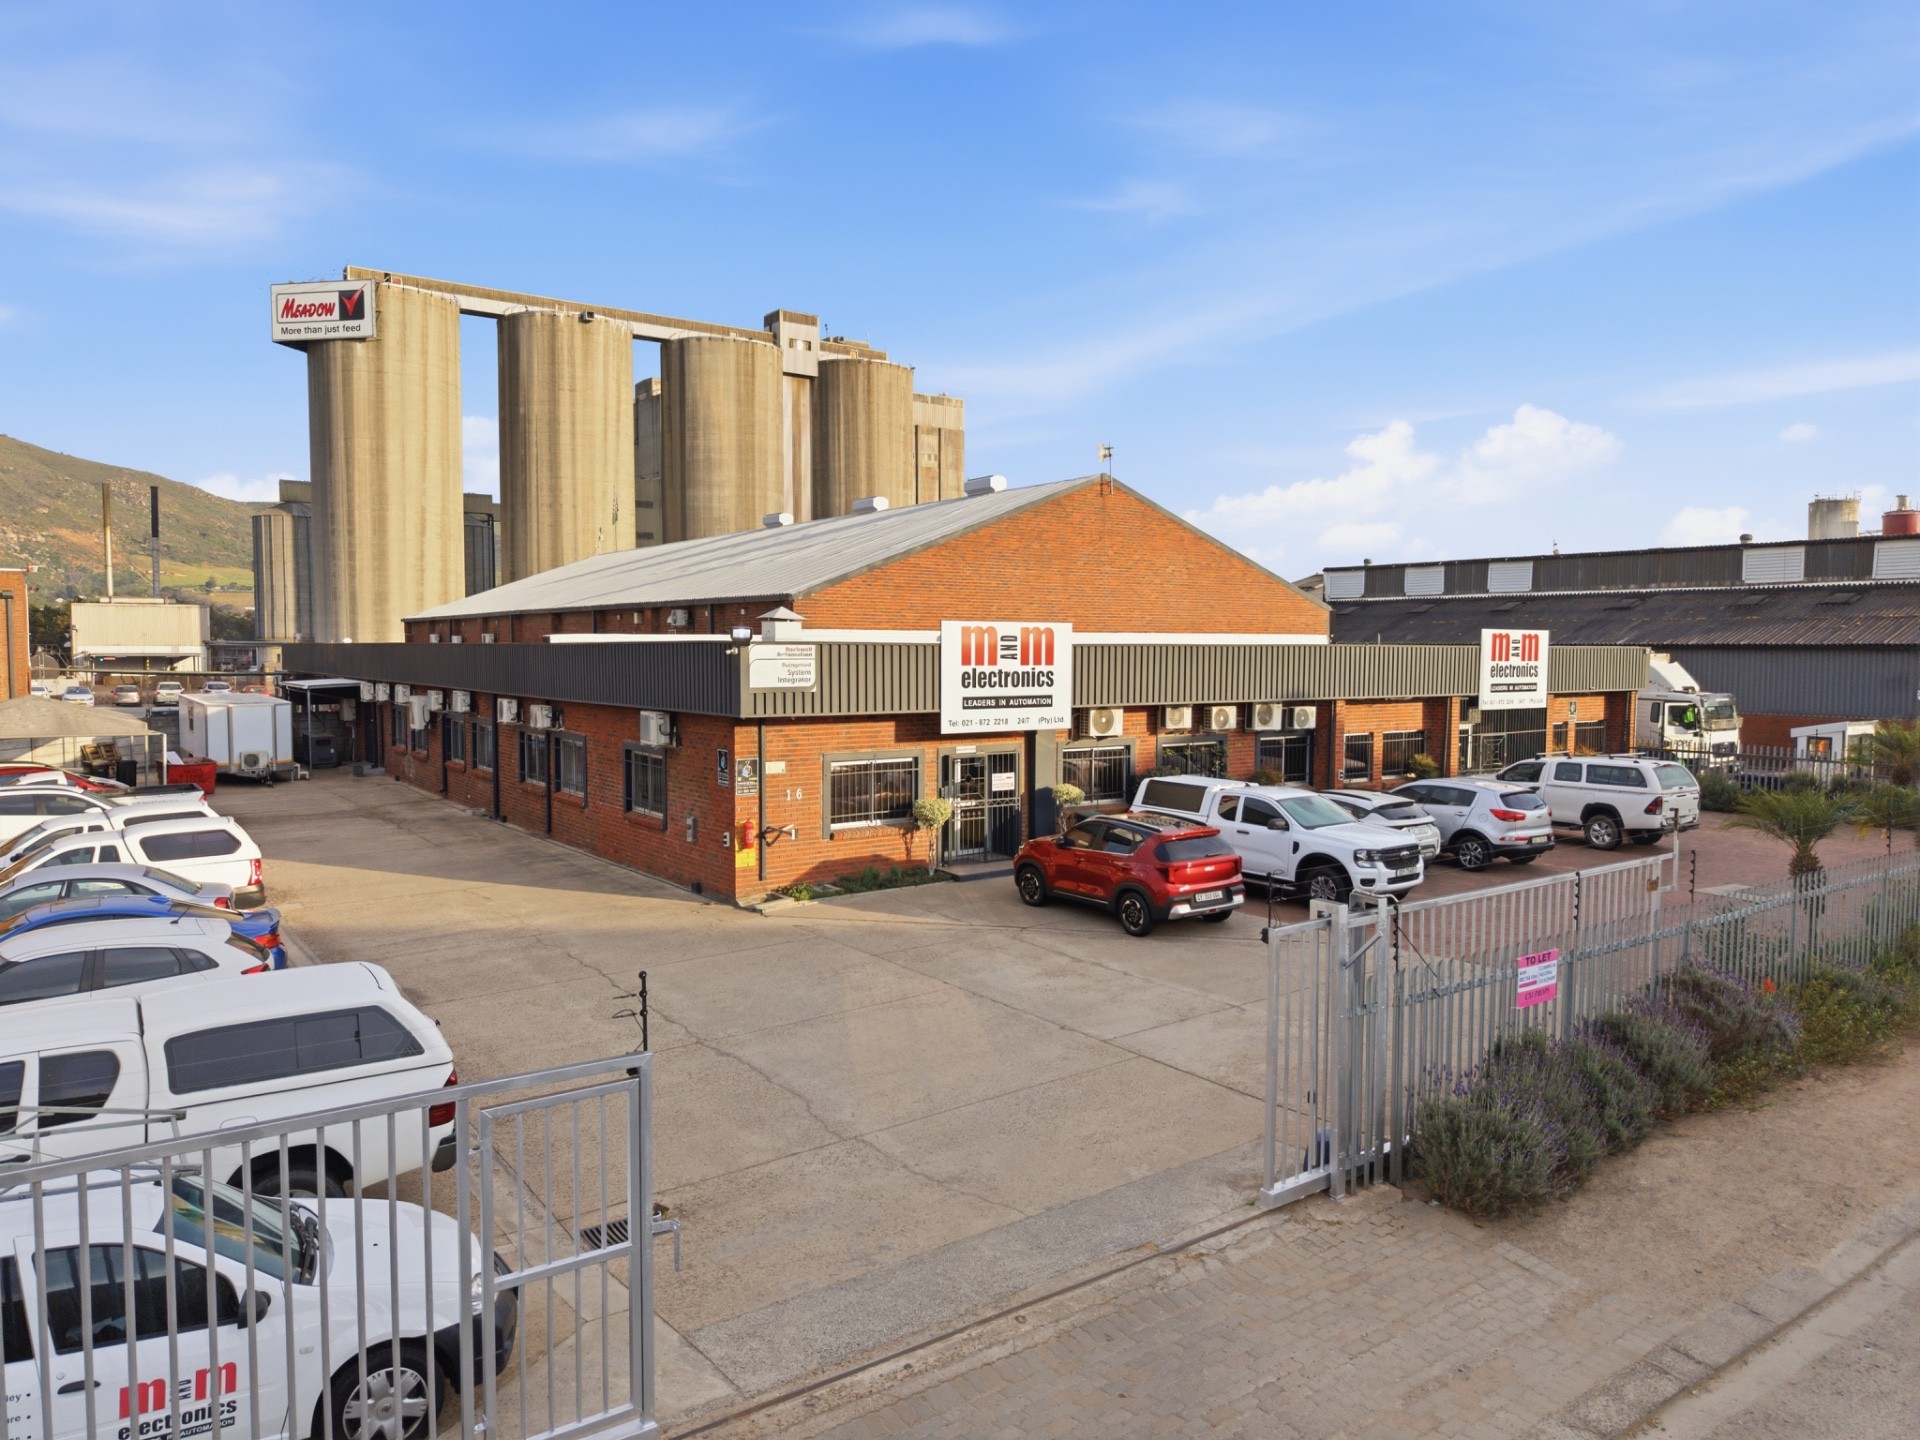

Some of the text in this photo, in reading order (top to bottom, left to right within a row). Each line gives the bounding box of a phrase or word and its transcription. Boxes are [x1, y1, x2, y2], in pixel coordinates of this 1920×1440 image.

[281, 298, 335, 319] MEADOW
[281, 327, 301, 335] More
[324, 325, 340, 335] just
[342, 323, 361, 332] feed
[961, 626, 1055, 666] m AND m
[1491, 633, 1539, 661] m AND m
[787, 669, 811, 677] System
[1490, 663, 1539, 678] electronics
[961, 667, 1055, 689] electronics
[964, 698, 1052, 707] LEADERS IN AUTOMATION
[994, 718, 1008, 726] 2218
[1038, 716, 1053, 725] (Pty)
[1525, 952, 1552, 966] TO LET
